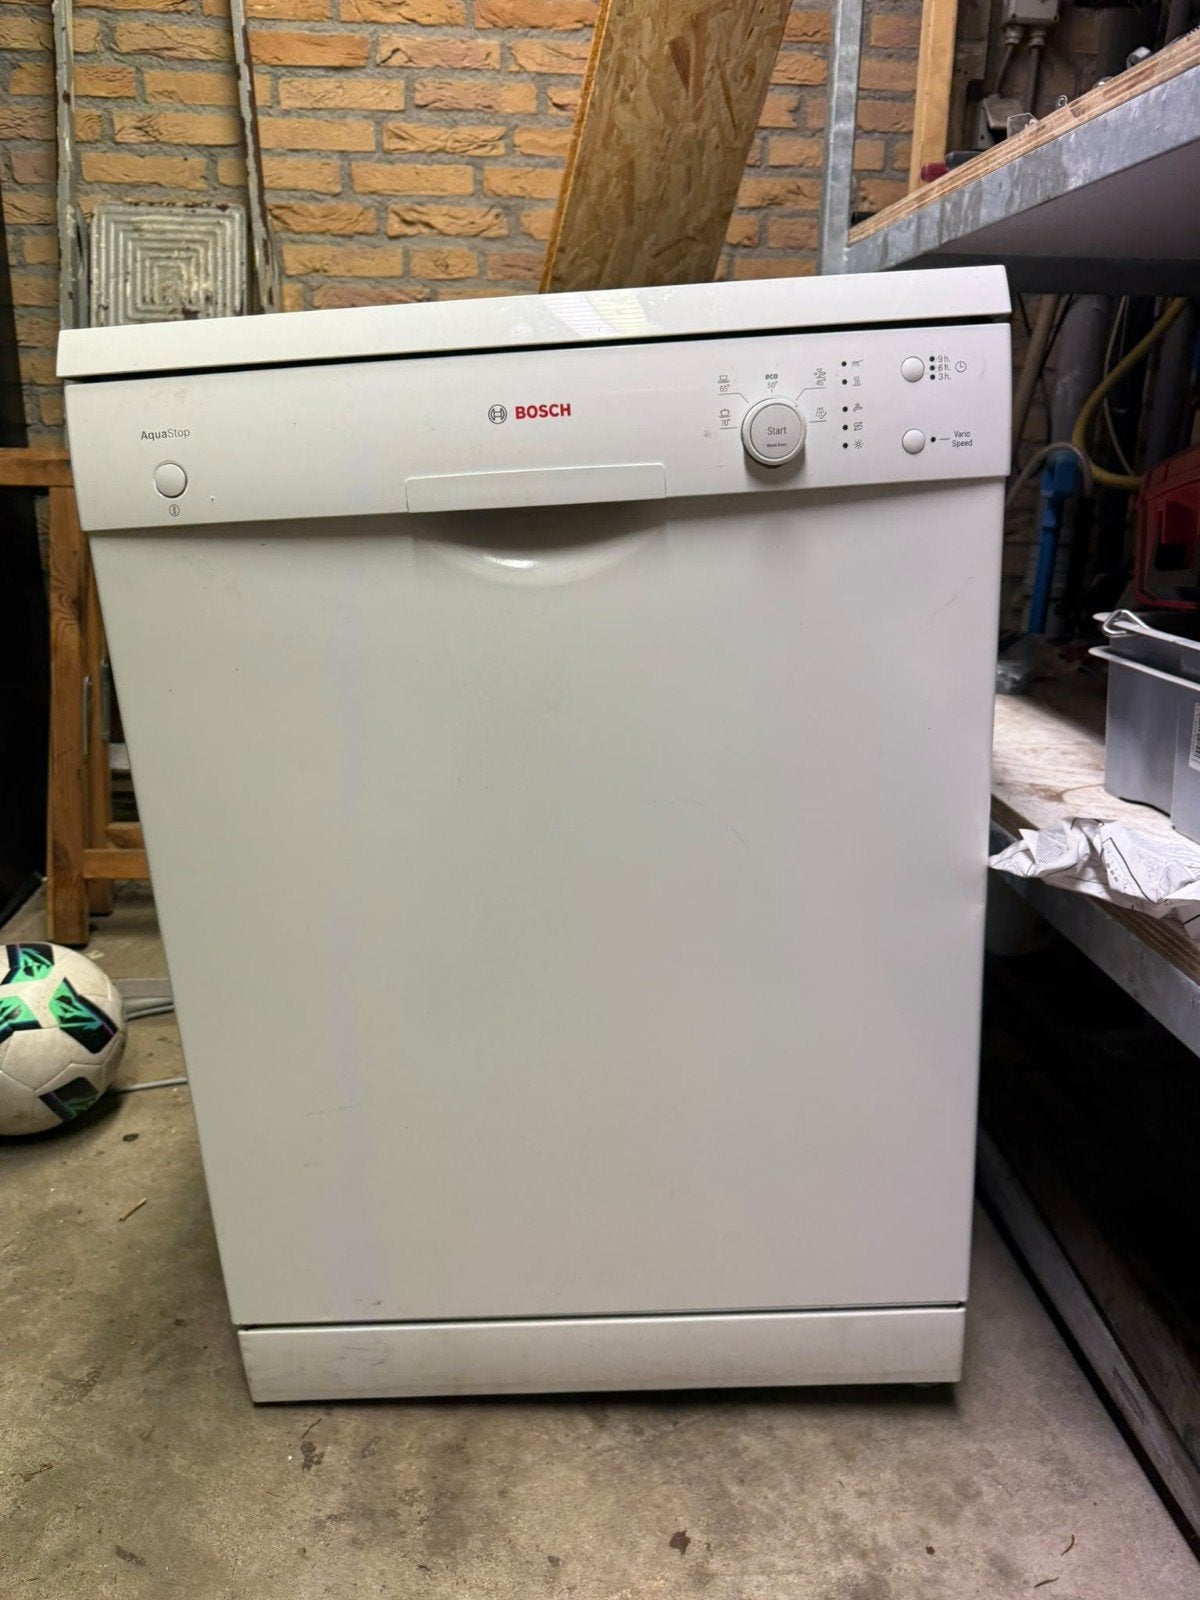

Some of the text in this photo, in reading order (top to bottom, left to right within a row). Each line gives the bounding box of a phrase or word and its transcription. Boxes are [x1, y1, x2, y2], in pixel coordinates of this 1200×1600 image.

[515, 403, 571, 419] BOSCH
[141, 428, 191, 441] AquaStop
[767, 426, 787, 436] Start
[953, 430, 970, 438] Vario
[952, 439, 973, 448] Speed
